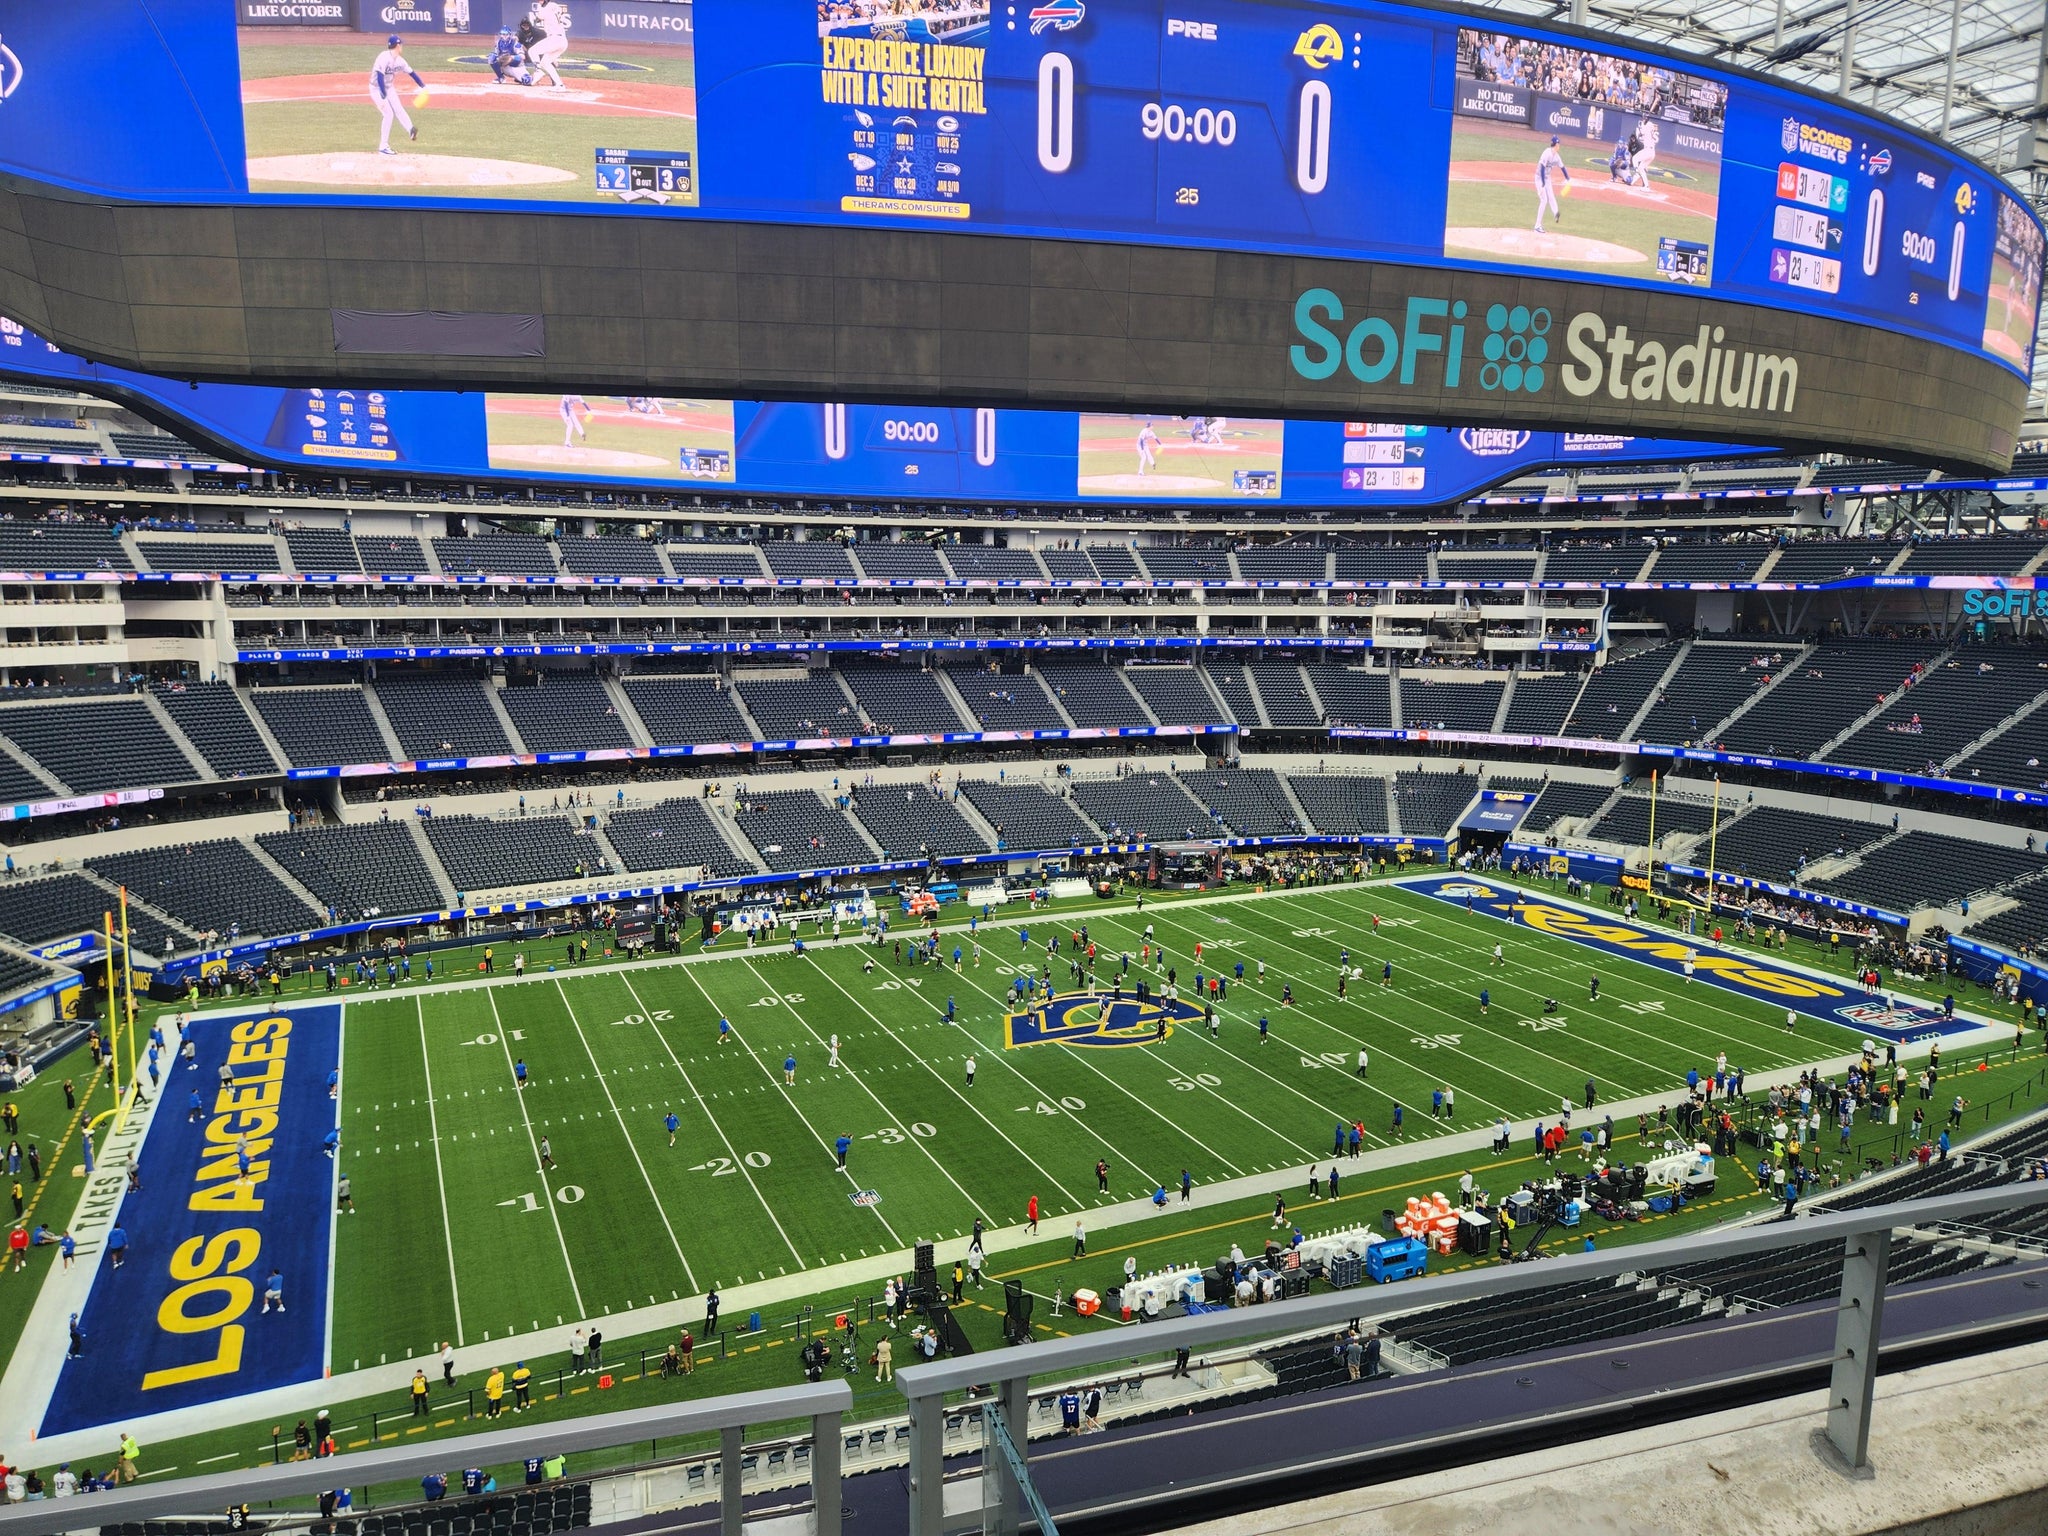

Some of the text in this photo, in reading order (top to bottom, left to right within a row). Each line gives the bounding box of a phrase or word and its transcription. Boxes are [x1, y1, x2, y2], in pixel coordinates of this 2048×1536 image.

[248, 5, 343, 18] LIKE OCTOBER
[381, 6, 432, 25] Corona
[604, 13, 694, 32] NUTRAFOL
[1167, 18, 1217, 40] PRE
[823, 36, 986, 80] EXPERIENCE LUXURY
[821, 70, 987, 114] WITH A SUITE RENTAL
[1477, 88, 1514, 103] NO TIME
[1037, 51, 1074, 173] 0
[1462, 98, 1526, 117] LIKE OCTOBER
[1141, 102, 1236, 146] 90:00
[1549, 111, 1580, 128] Corona
[1297, 79, 1331, 194] 0
[1676, 133, 1721, 154] NUTRAFOL
[1799, 123, 1852, 152] SCORES
[1799, 139, 1839, 162] WEEK
[614, 167, 626, 188] 2
[662, 169, 674, 190] 3
[1916, 171, 1936, 190] PRE
[1175, 187, 1199, 205] :25
[1799, 177, 1829, 203] 31 24
[852, 199, 961, 214] THERAMS.COM/SUITES
[1795, 213, 1825, 249] 17 45
[1862, 188, 1885, 277] 0
[1901, 230, 1936, 264] 90:00
[1666, 253, 1700, 273] 2 3
[1947, 220, 1966, 301] 0
[1791, 257, 1821, 285] 23 13
[5, 335, 22, 347] YDS
[1290, 287, 1798, 413] SoFi Stadium
[883, 419, 939, 443] 90:00
[1471, 430, 1519, 449] TICKET
[1367, 444, 1402, 460] 17 45
[1583, 442, 1624, 450] RECEIVERS
[689, 458, 721, 471] 2 3
[1366, 471, 1401, 486] 23 13
[1963, 588, 2031, 616] SoFi
[1621, 874, 1649, 890] 90:00
[440, 884, 683, 920] RAMS HOUSE
[1800, 891, 1868, 915] HOUSE
[42, 938, 82, 958] RAMS
[1497, 903, 1844, 999] RAMS
[624, 1008, 675, 1025] 20
[1517, 1016, 1567, 1031] 20
[473, 1028, 528, 1046] 10
[1410, 1032, 1461, 1052] 30
[1299, 1052, 1347, 1070] 40
[1166, 1073, 1222, 1092] 50
[1034, 1096, 1087, 1117] 40
[876, 1122, 938, 1145] 30
[705, 1151, 772, 1178] 20
[75, 1173, 125, 1232] TAKES
[141, 1016, 294, 1392] LOS ANGELES
[516, 1184, 586, 1214] 10
[73, 1238, 97, 1257] IT
[1079, 1300, 1088, 1311] G
[1066, 1404, 1076, 1413] 17
[528, 1462, 538, 1472] 17
[56, 1481, 65, 1490] 17
[467, 1478, 476, 1487] 17
